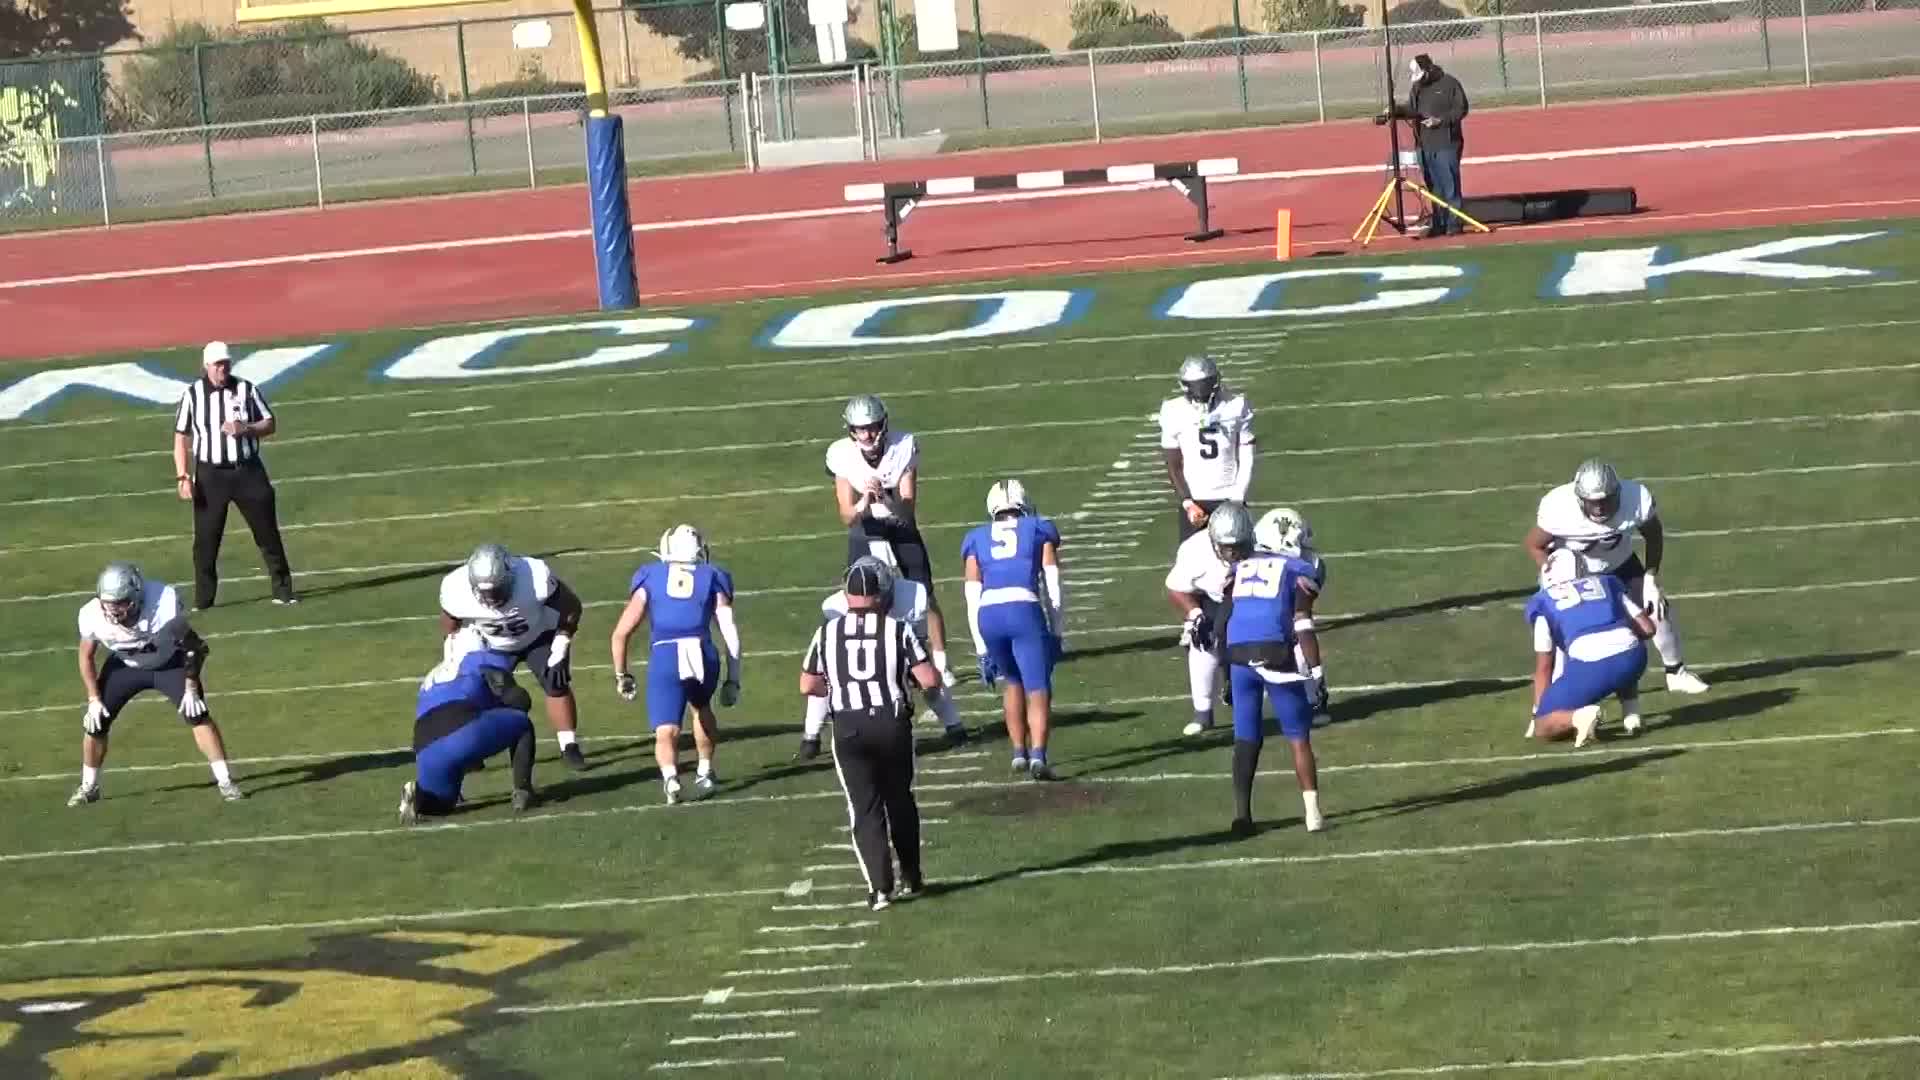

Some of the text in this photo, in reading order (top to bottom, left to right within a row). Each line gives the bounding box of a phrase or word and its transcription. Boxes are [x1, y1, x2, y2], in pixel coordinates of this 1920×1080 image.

[1198, 427, 1219, 460] 5
[990, 518, 1018, 559] 5
[666, 563, 695, 599] 6
[844, 639, 877, 680] U
